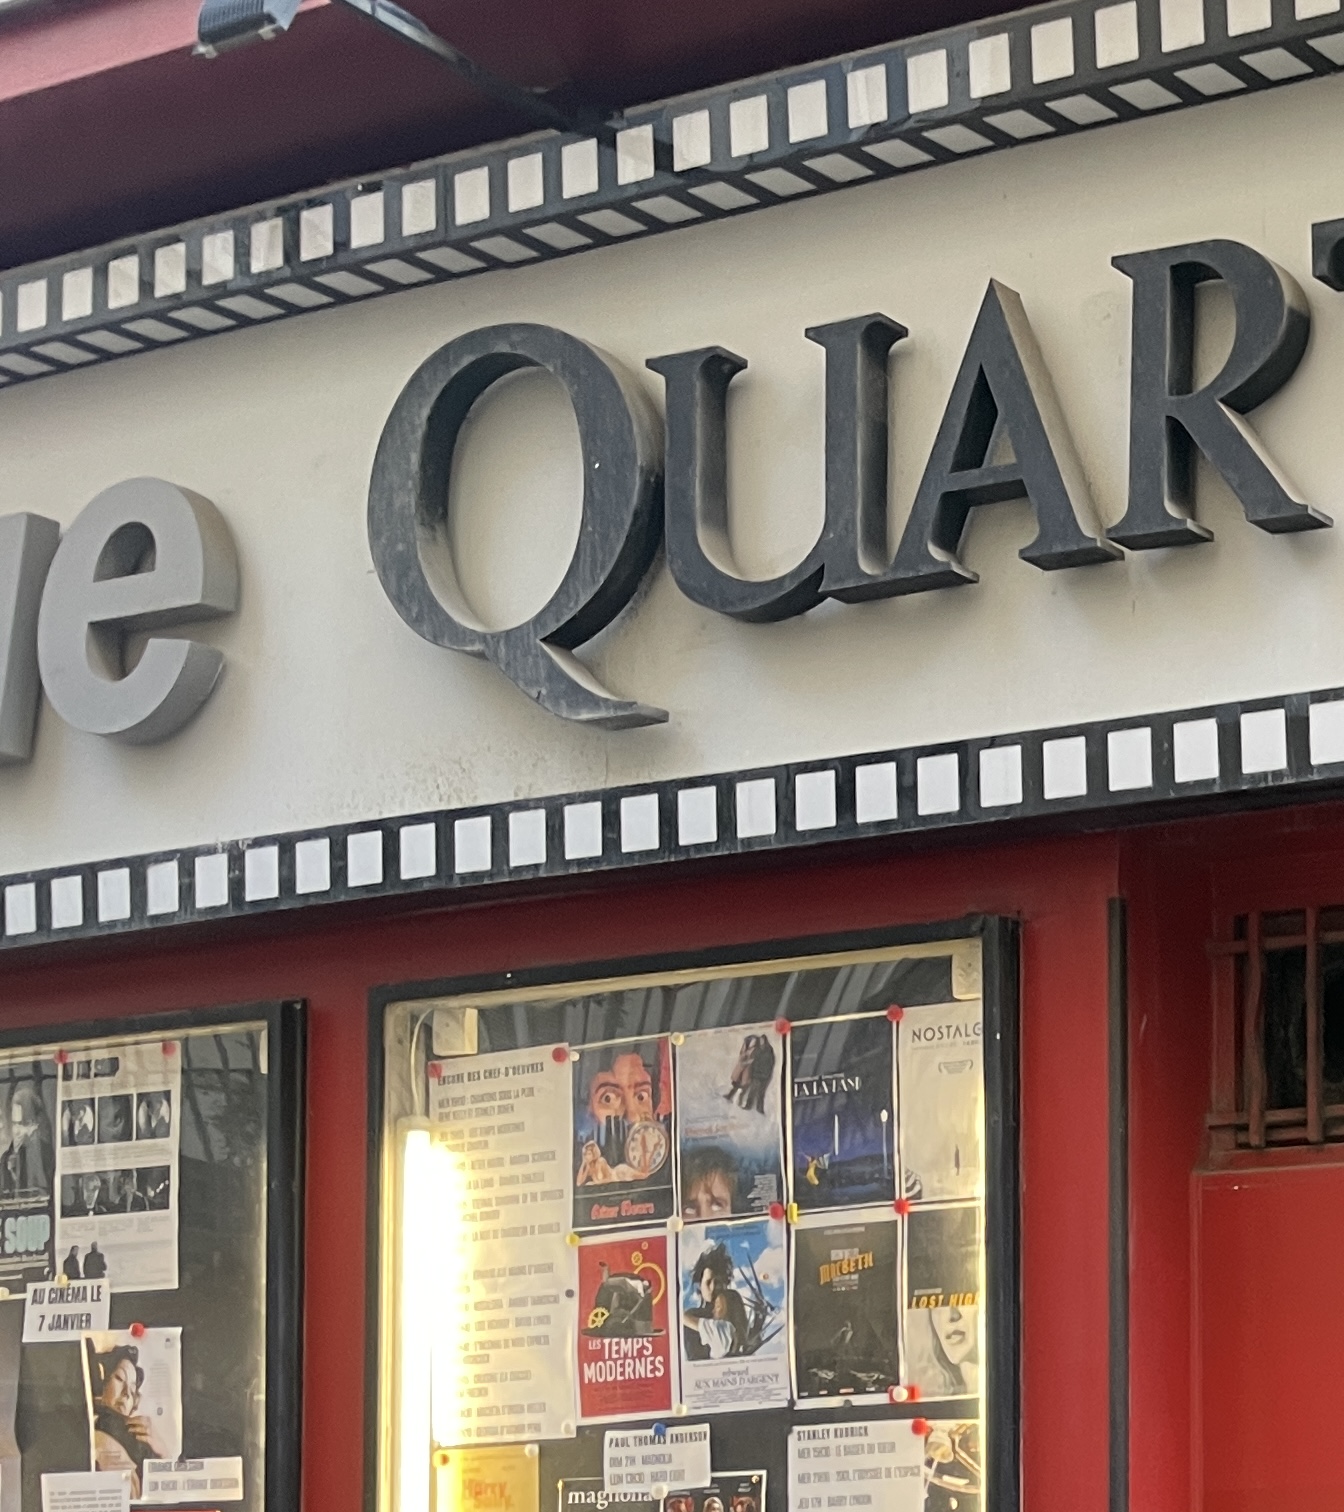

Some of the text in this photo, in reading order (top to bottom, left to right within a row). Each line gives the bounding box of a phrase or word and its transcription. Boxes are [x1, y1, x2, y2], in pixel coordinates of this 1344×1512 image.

[31, 1287, 45, 1305] AU
[91, 1285, 102, 1302] LE
[911, 1294, 944, 1309] LOST
[39, 1314, 91, 1331] 7 JANVIER
[588, 1337, 653, 1359] LES TEMPS
[584, 1356, 664, 1384] MODERNES
[609, 1435, 630, 1447] PAUL
[797, 1425, 869, 1442] STANLEY KUBRICK
